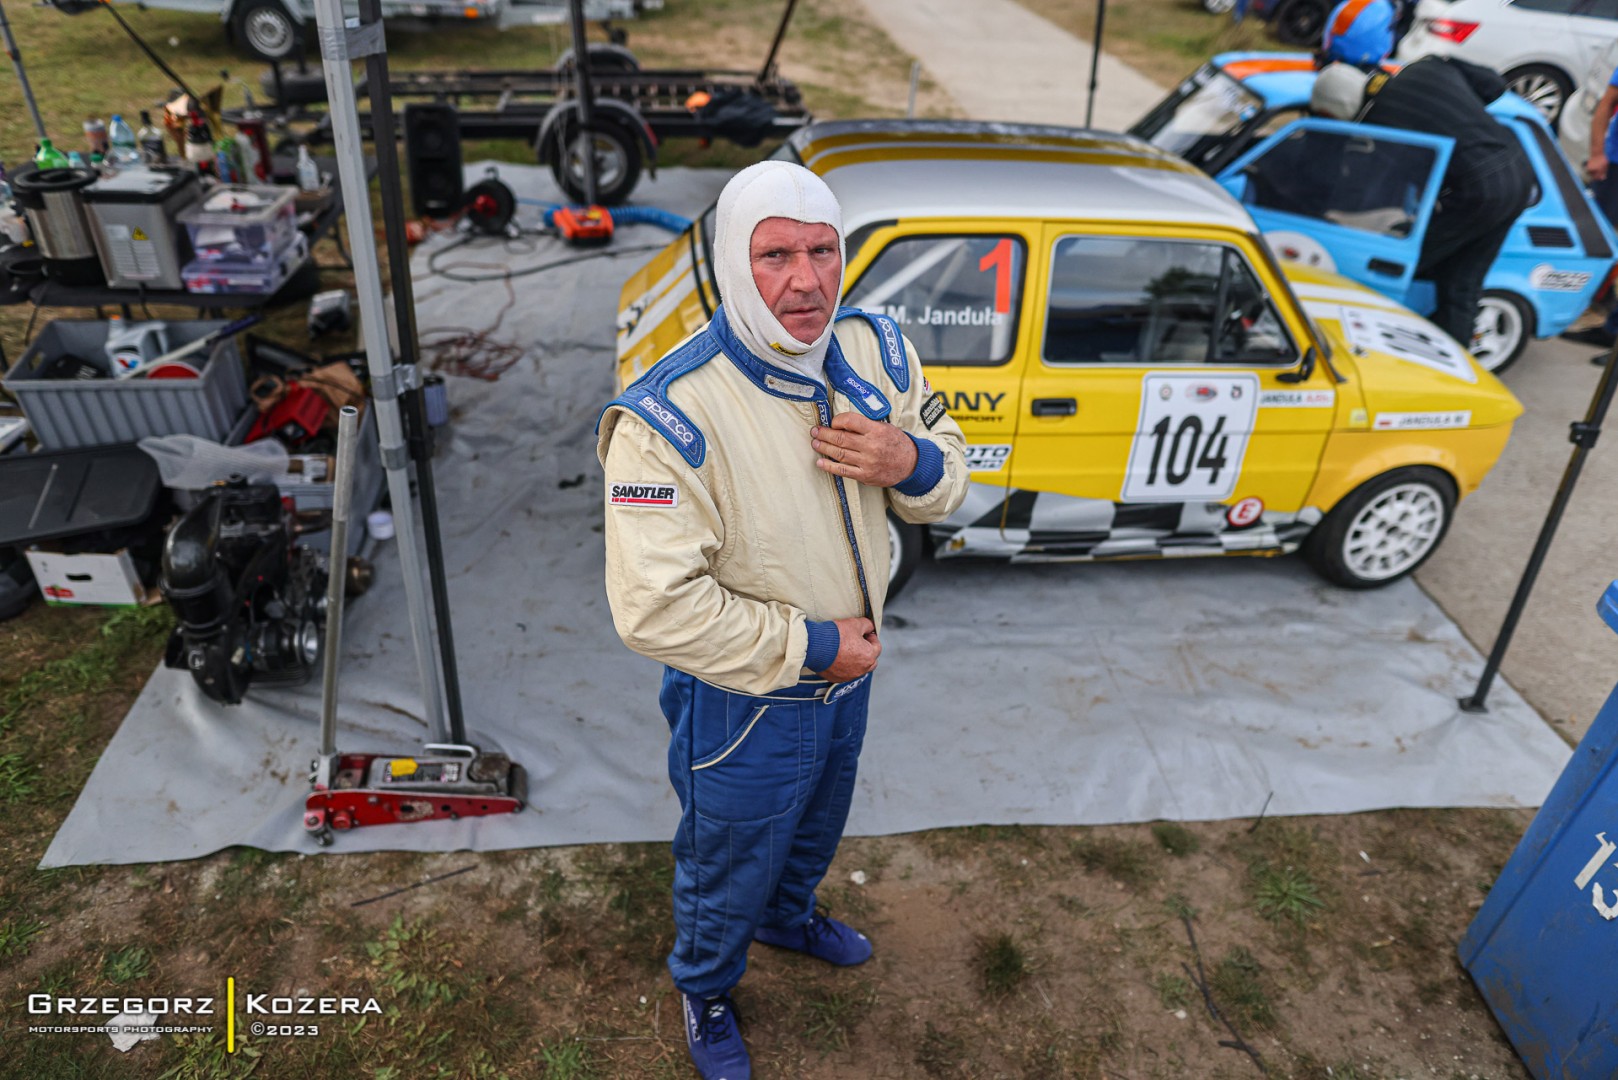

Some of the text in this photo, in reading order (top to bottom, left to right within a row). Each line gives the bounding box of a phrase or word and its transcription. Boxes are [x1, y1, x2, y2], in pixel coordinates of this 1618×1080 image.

[979, 238, 1013, 314] 1
[640, 396, 694, 446] sparco
[1146, 414, 1228, 486] 104
[612, 485, 675, 500] SANDTLER
[1237, 502, 1257, 520] E
